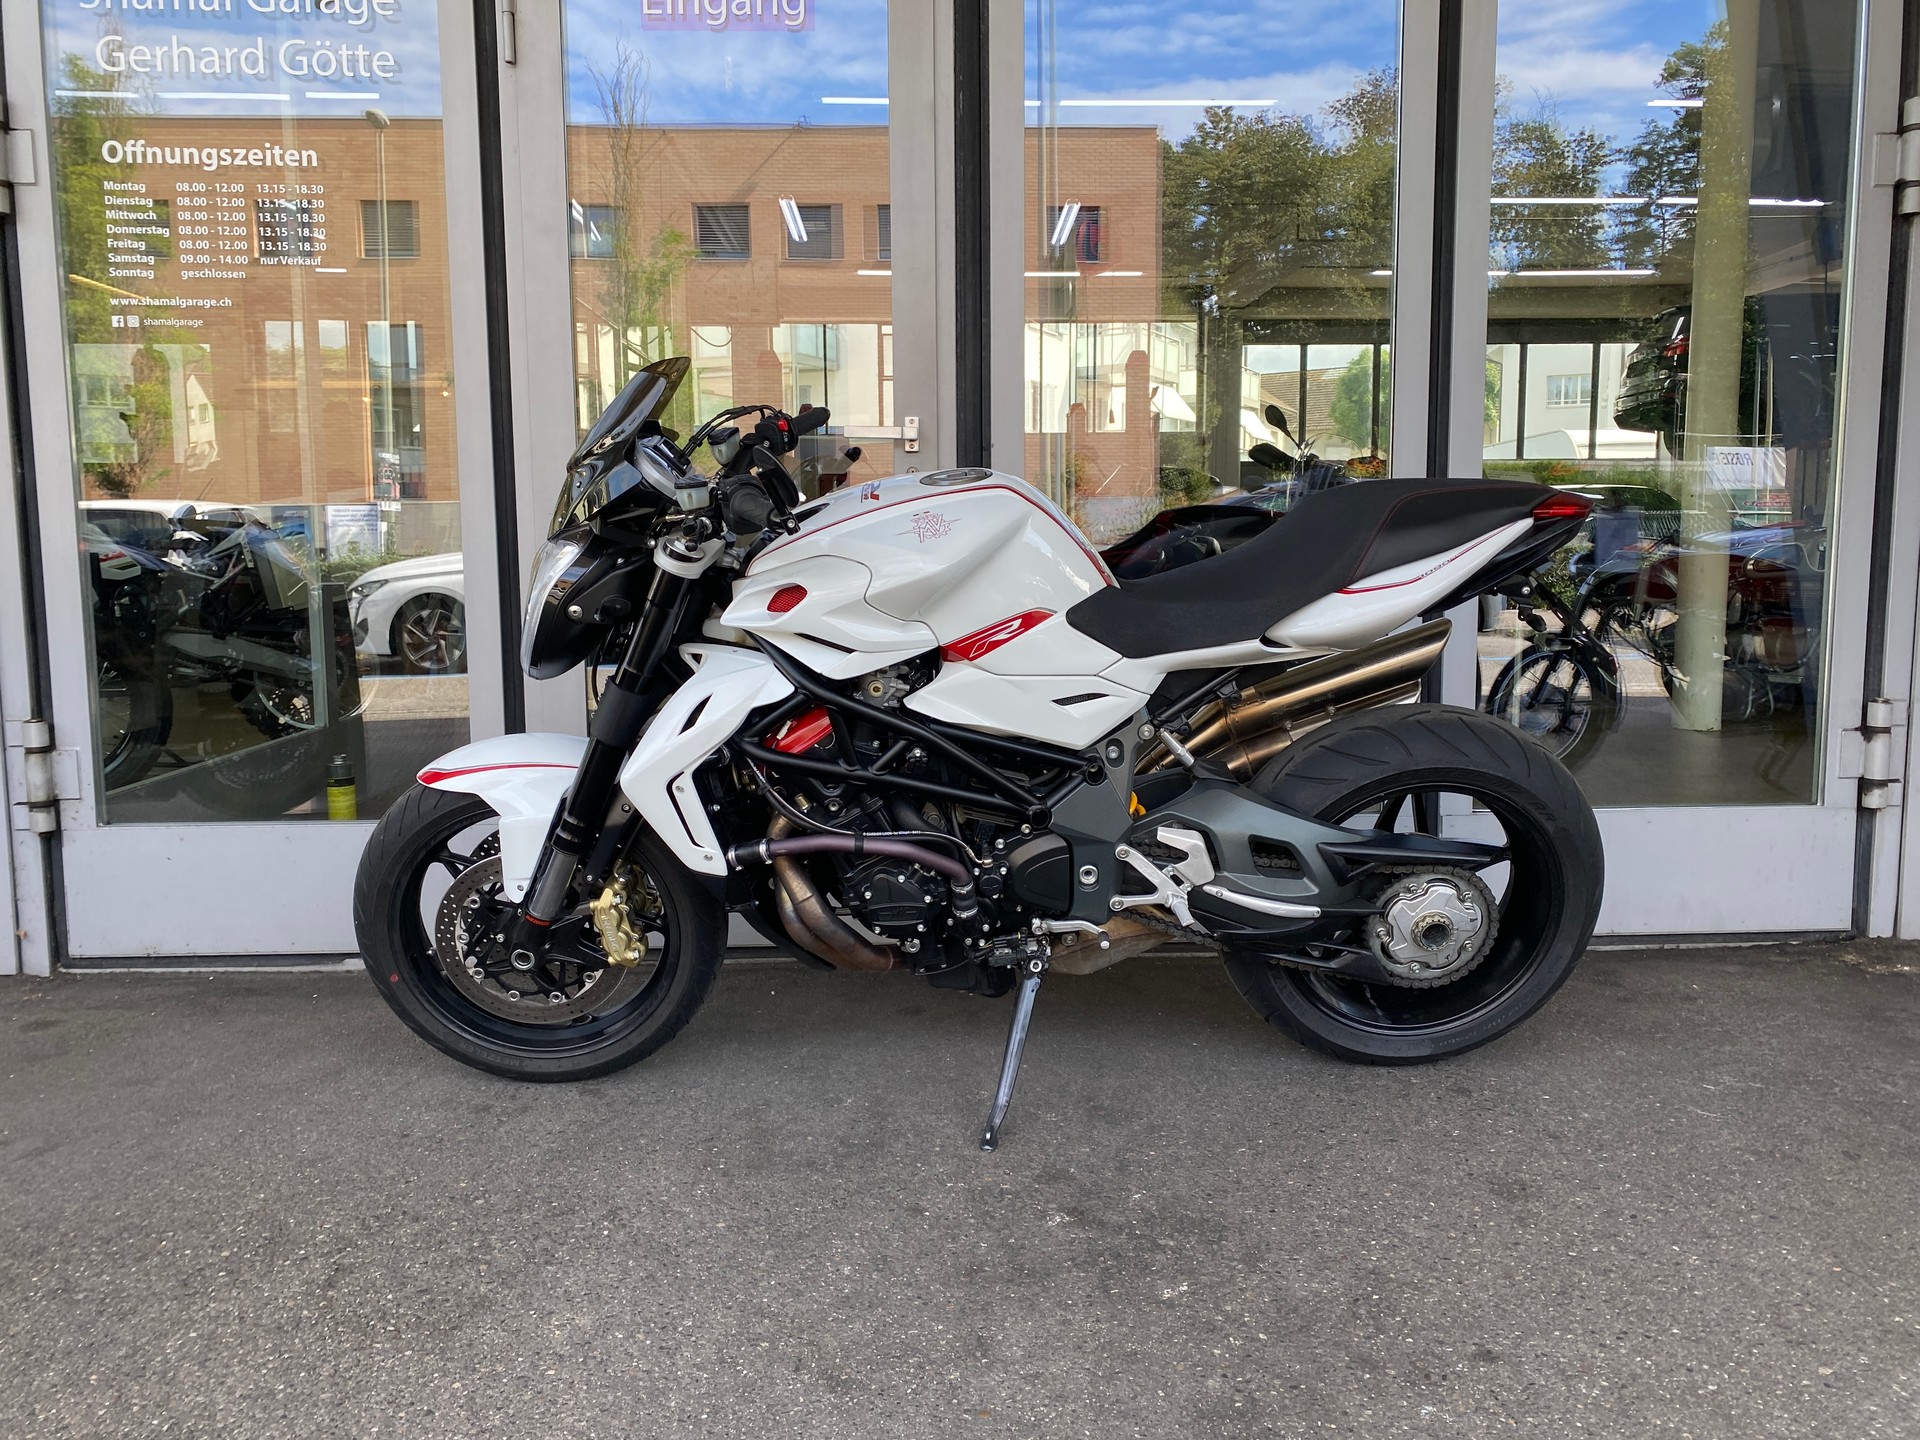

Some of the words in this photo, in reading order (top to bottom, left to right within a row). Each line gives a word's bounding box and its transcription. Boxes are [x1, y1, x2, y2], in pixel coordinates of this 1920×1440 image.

[95, 35, 264, 75] Gerhard
[278, 40, 395, 77] Götte
[103, 181, 146, 193] Montag
[176, 183, 206, 192] 08.00
[215, 183, 244, 193] 12.00
[256, 184, 286, 194] 13.15
[295, 185, 324, 194] 18.30
[104, 195, 153, 207] Dienstag
[177, 197, 206, 206] 08.00
[216, 198, 245, 207] 12.00
[257, 199, 286, 208] 13.15
[295, 199, 324, 208] 18.30
[105, 210, 156, 220] Mittwoch
[177, 212, 207, 221] 08.00
[216, 212, 246, 221] 12.00
[258, 213, 287, 222] 13.15
[296, 214, 325, 223] 18.30
[106, 224, 170, 237] Donnerstag
[178, 226, 208, 235] 08.00
[217, 226, 247, 236] 12.00
[258, 227, 288, 236] 13.15
[107, 238, 146, 250] Freitag
[179, 240, 209, 249] 08.00
[218, 241, 248, 250] 12.00
[259, 241, 288, 250] 13.15
[298, 242, 327, 251] 18.30
[108, 253, 155, 265] Samstag
[180, 254, 210, 264] 09.00
[219, 255, 249, 264] 14.00
[260, 257, 279, 265] nur
[280, 256, 322, 266] Verkauf
[108, 267, 155, 279] Sonntag
[181, 268, 246, 280] geschlossen
[110, 296, 232, 308] www.shamalgarage.ch
[143, 317, 204, 328] shamalgarage
